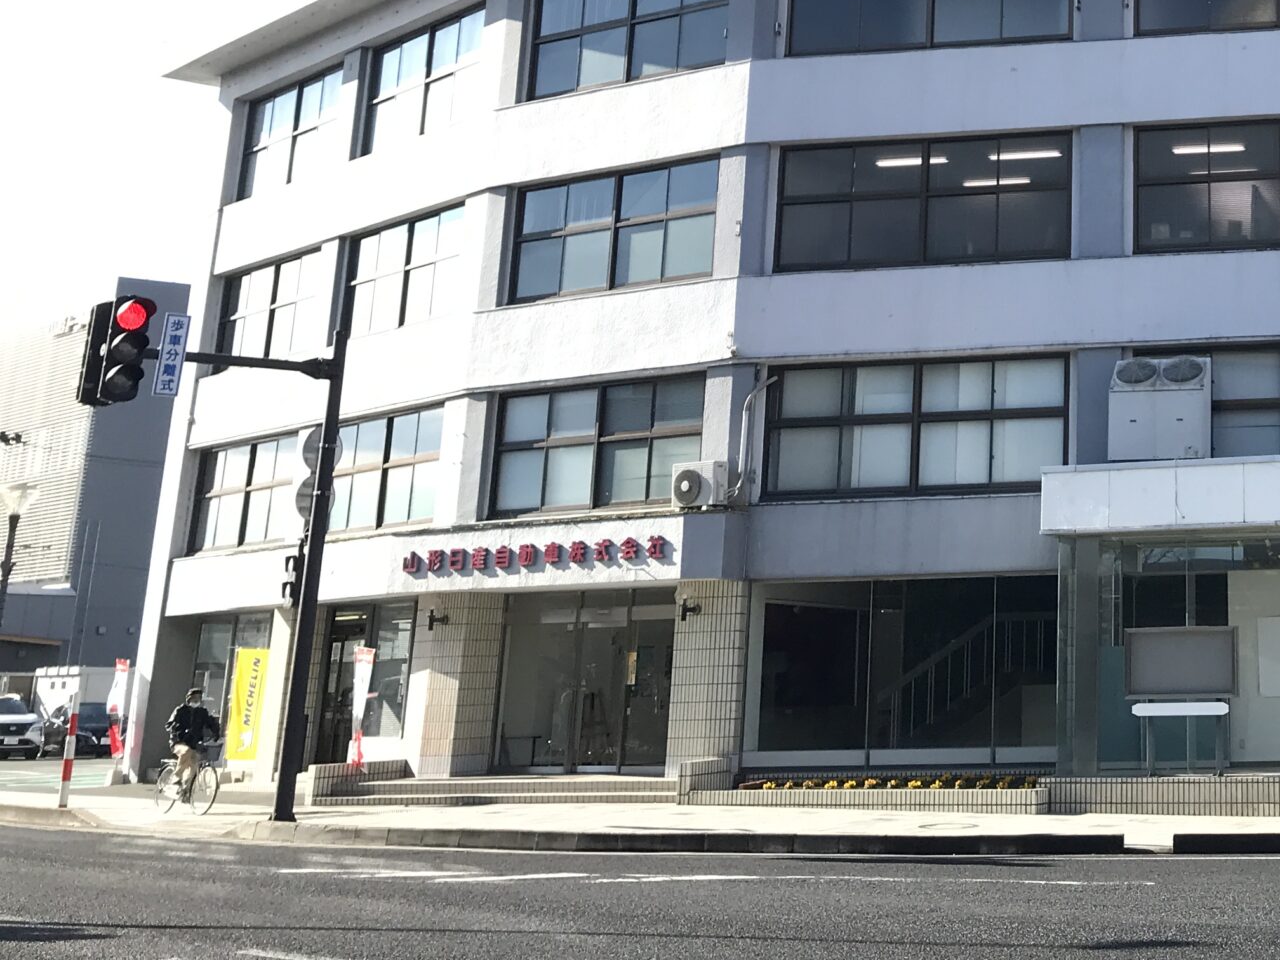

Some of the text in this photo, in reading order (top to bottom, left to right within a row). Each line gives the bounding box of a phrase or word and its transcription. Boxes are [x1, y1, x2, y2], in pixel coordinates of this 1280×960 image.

[160, 319, 185, 392] 歩車分離式
[402, 535, 665, 573] 山形日産自動車株式会社
[243, 657, 261, 727] MICHELIN
